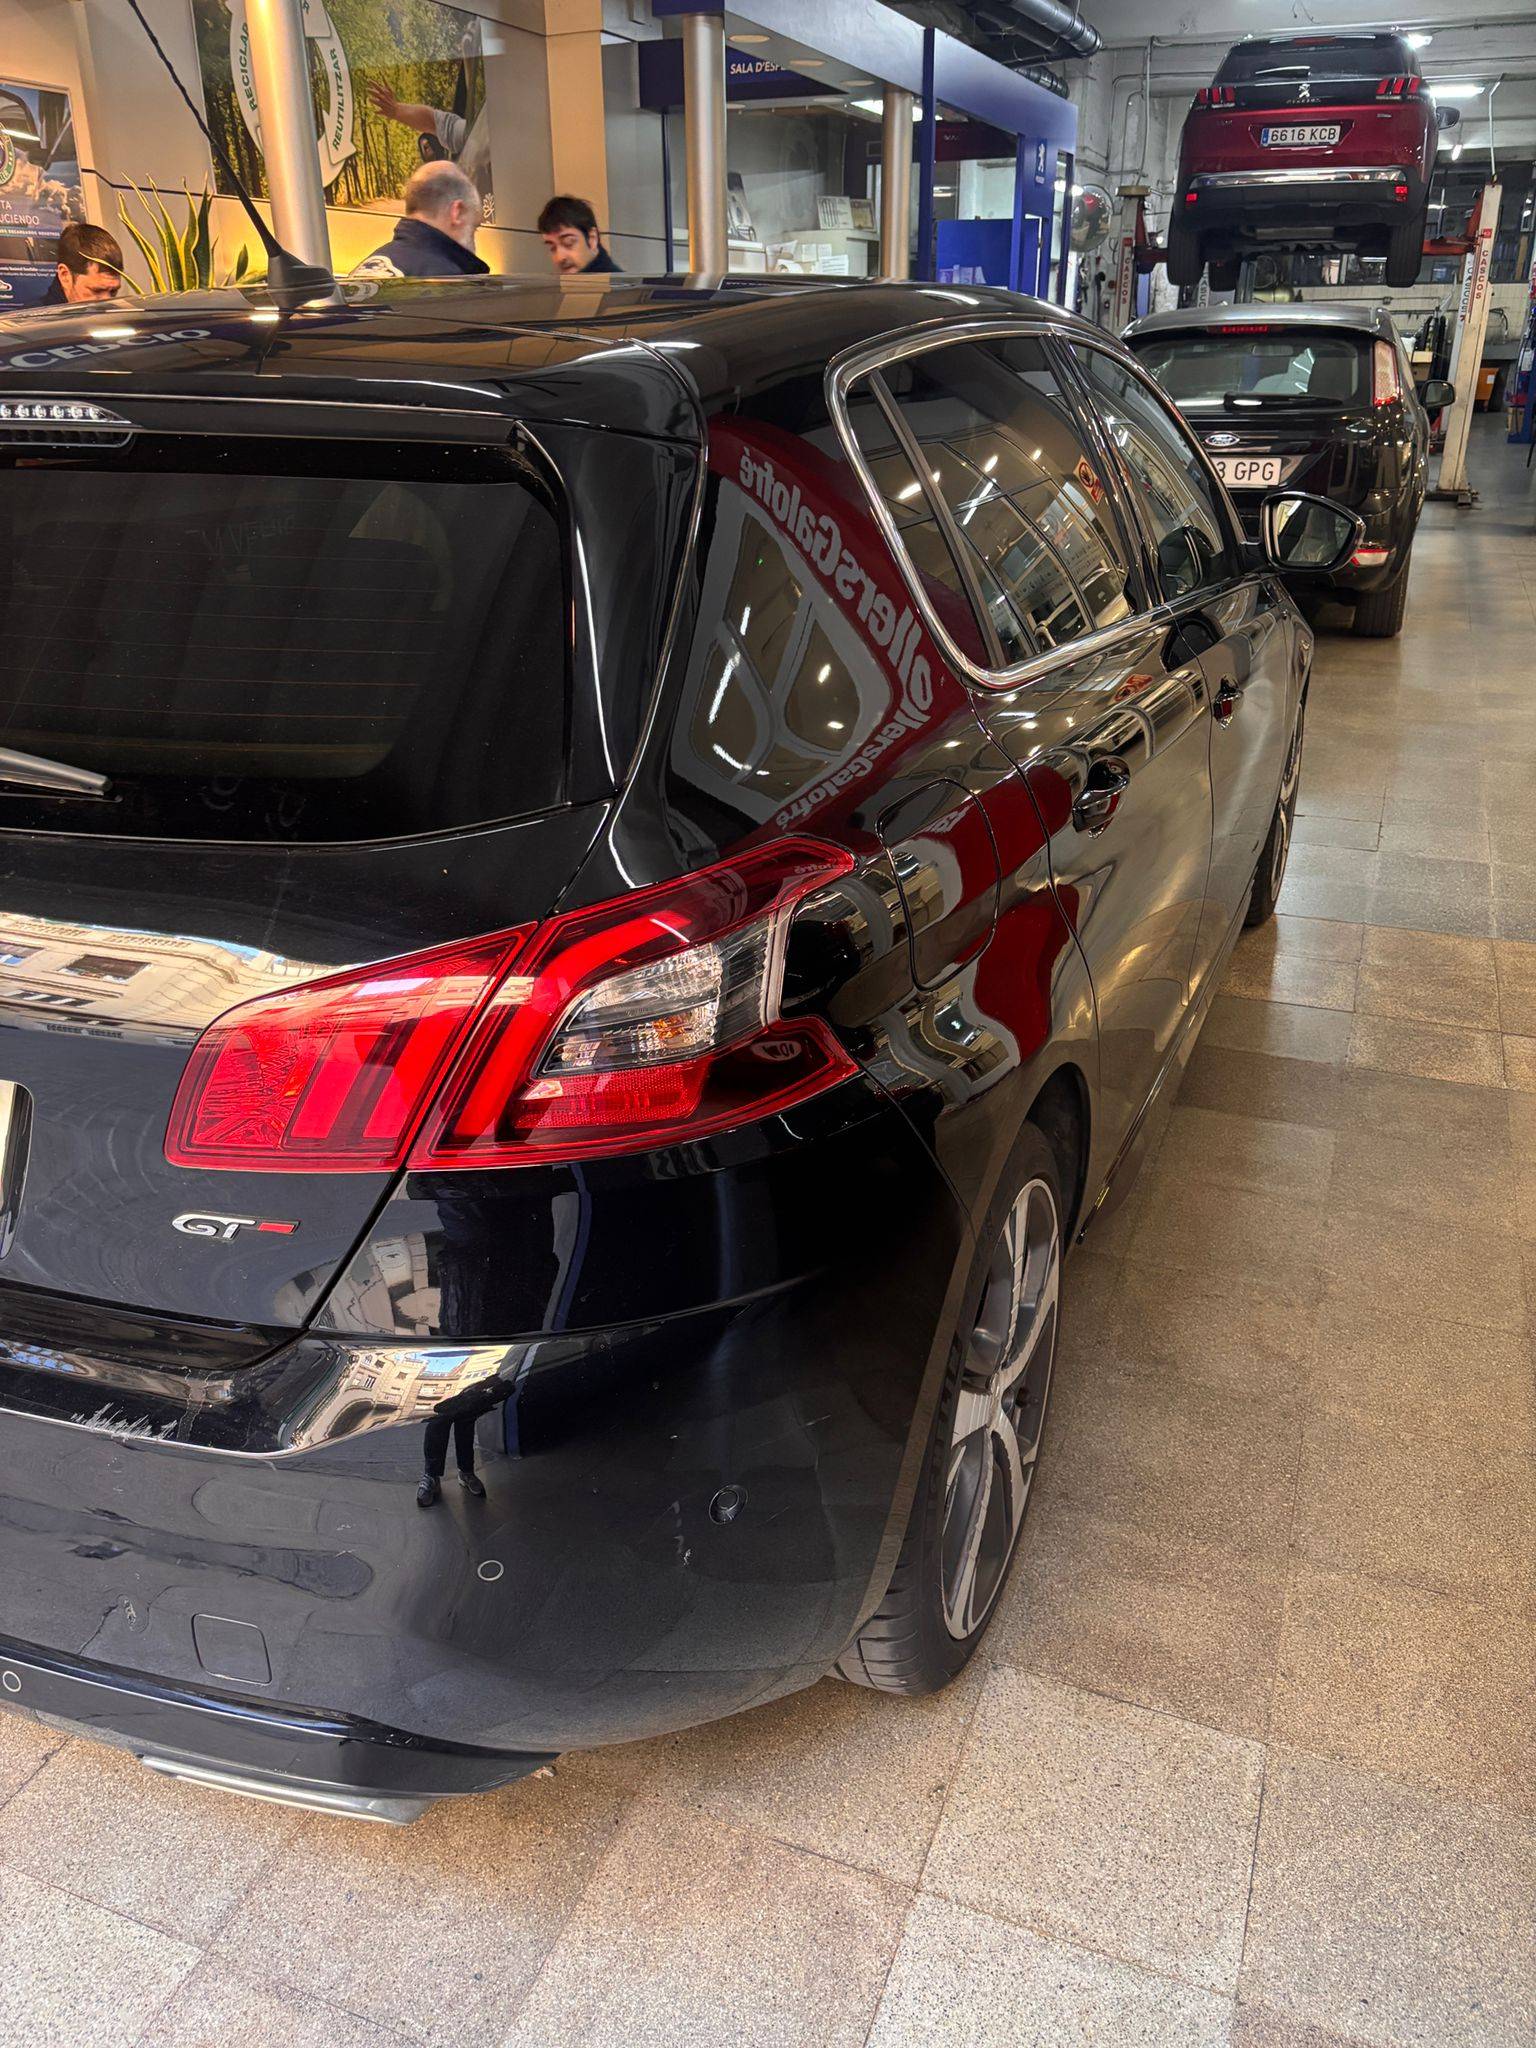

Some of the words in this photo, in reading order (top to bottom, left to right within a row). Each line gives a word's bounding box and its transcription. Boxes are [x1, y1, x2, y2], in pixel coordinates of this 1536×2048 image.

[730, 62, 753, 74] SALA
[329, 48, 345, 151] REUTILITZAR
[1271, 129, 1306, 142] 6616
[1309, 127, 1336, 140] KCB
[1122, 257, 1130, 304] CASCOS
[1476, 250, 1488, 299] CASCOS
[1234, 462, 1274, 481] GPG
[172, 1213, 255, 1239] GT
